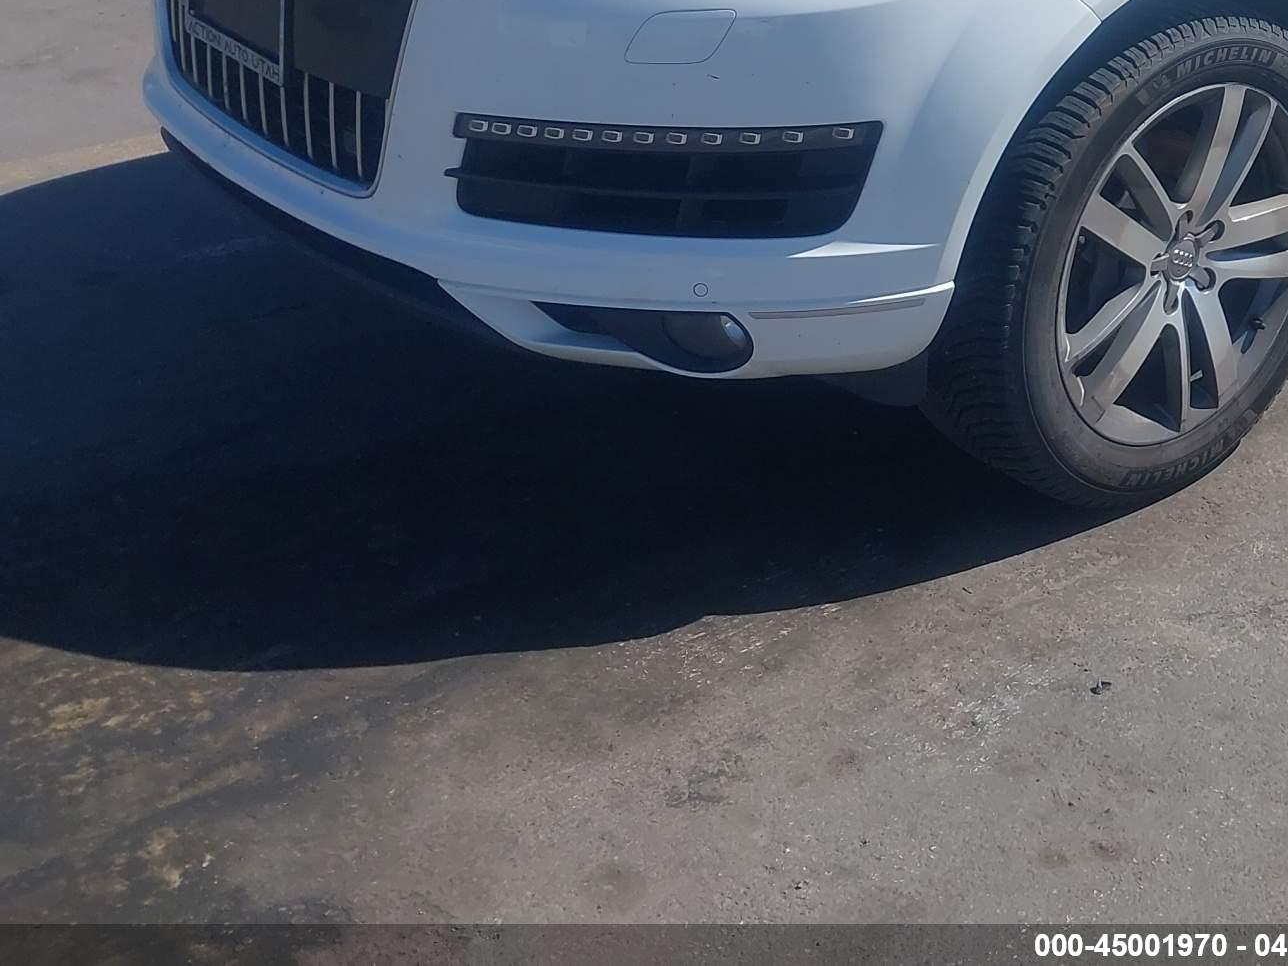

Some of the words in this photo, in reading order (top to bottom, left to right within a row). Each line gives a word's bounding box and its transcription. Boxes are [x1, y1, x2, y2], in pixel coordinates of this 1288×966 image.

[224, 40, 249, 61] AUTO
[251, 53, 281, 80] UTAH
[1176, 46, 1274, 79] MICHELIN
